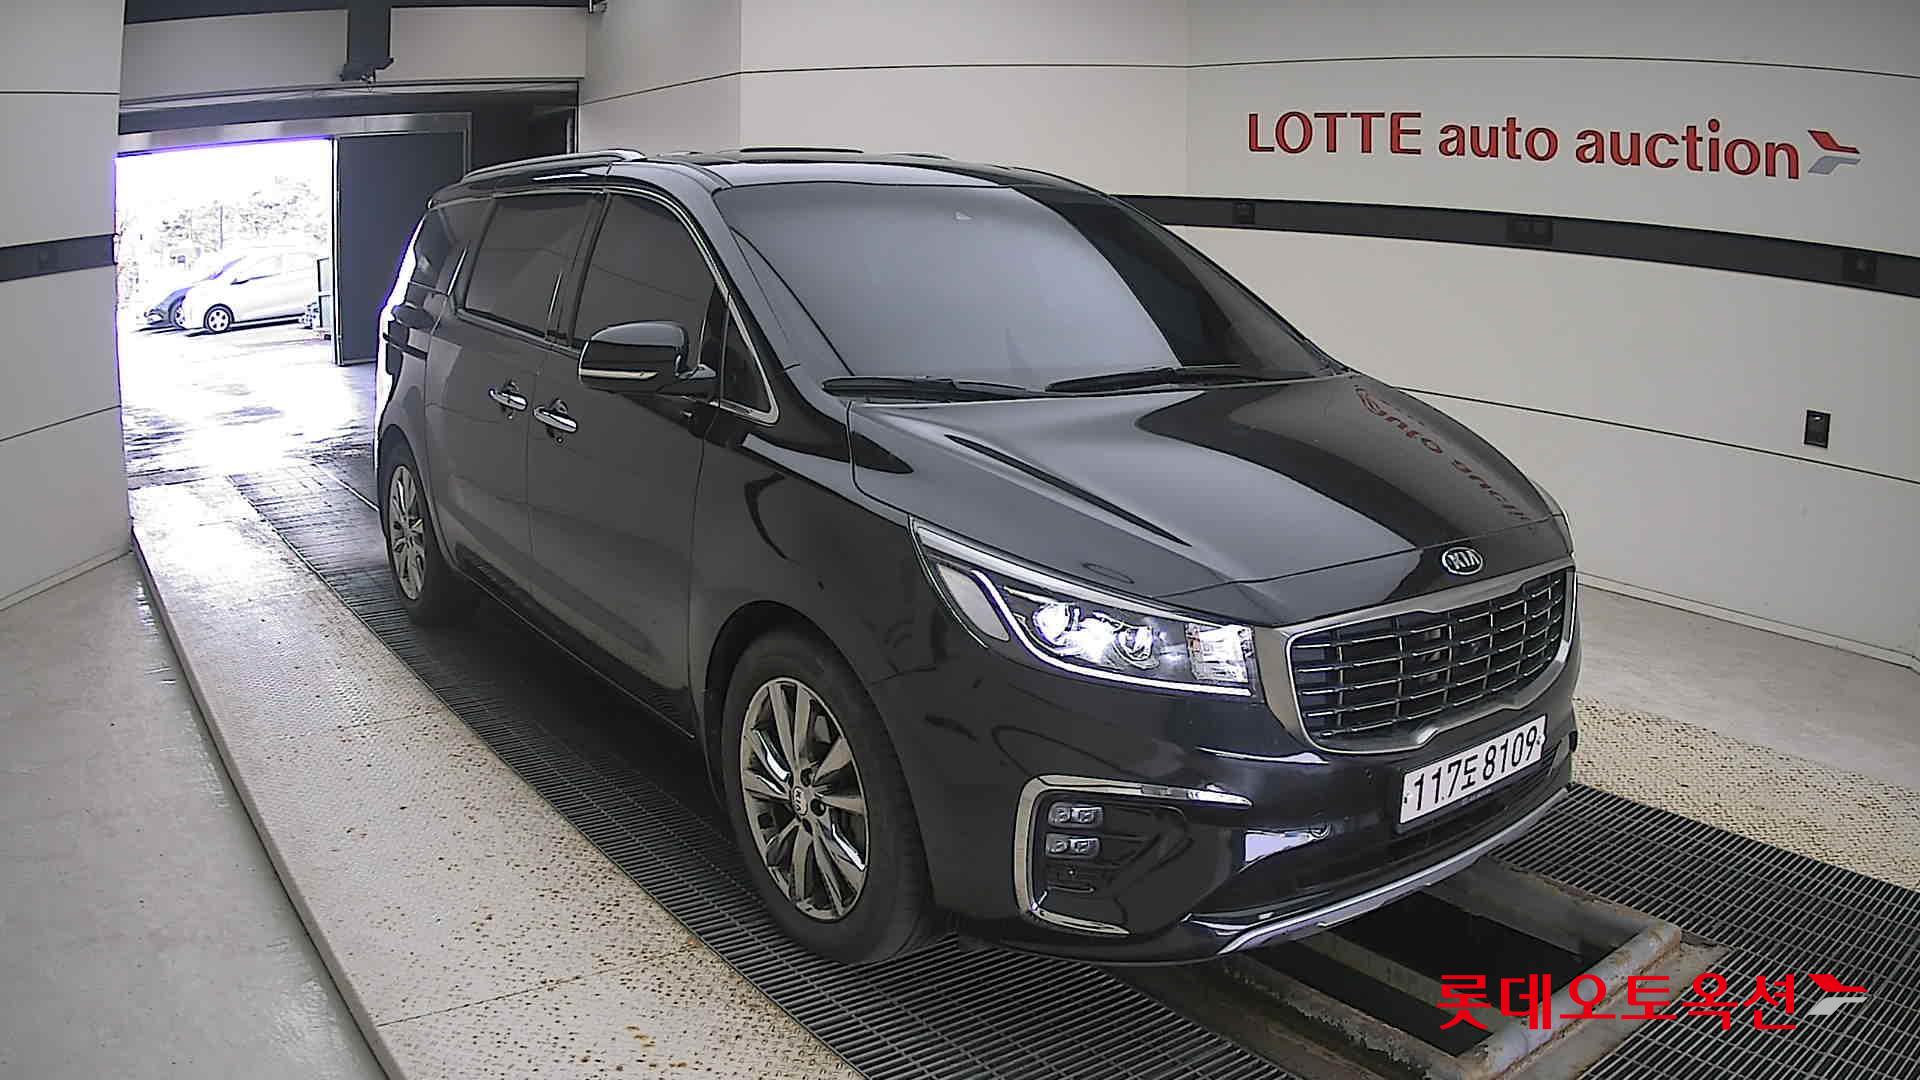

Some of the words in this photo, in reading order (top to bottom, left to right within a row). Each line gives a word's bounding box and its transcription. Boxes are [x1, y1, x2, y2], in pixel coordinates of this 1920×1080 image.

[1247, 111, 1422, 155] LOTTE
[1437, 116, 1560, 161] auto
[1574, 118, 1801, 180] auction
[1446, 549, 1481, 571] KIA
[1482, 725, 1538, 781] 8109
